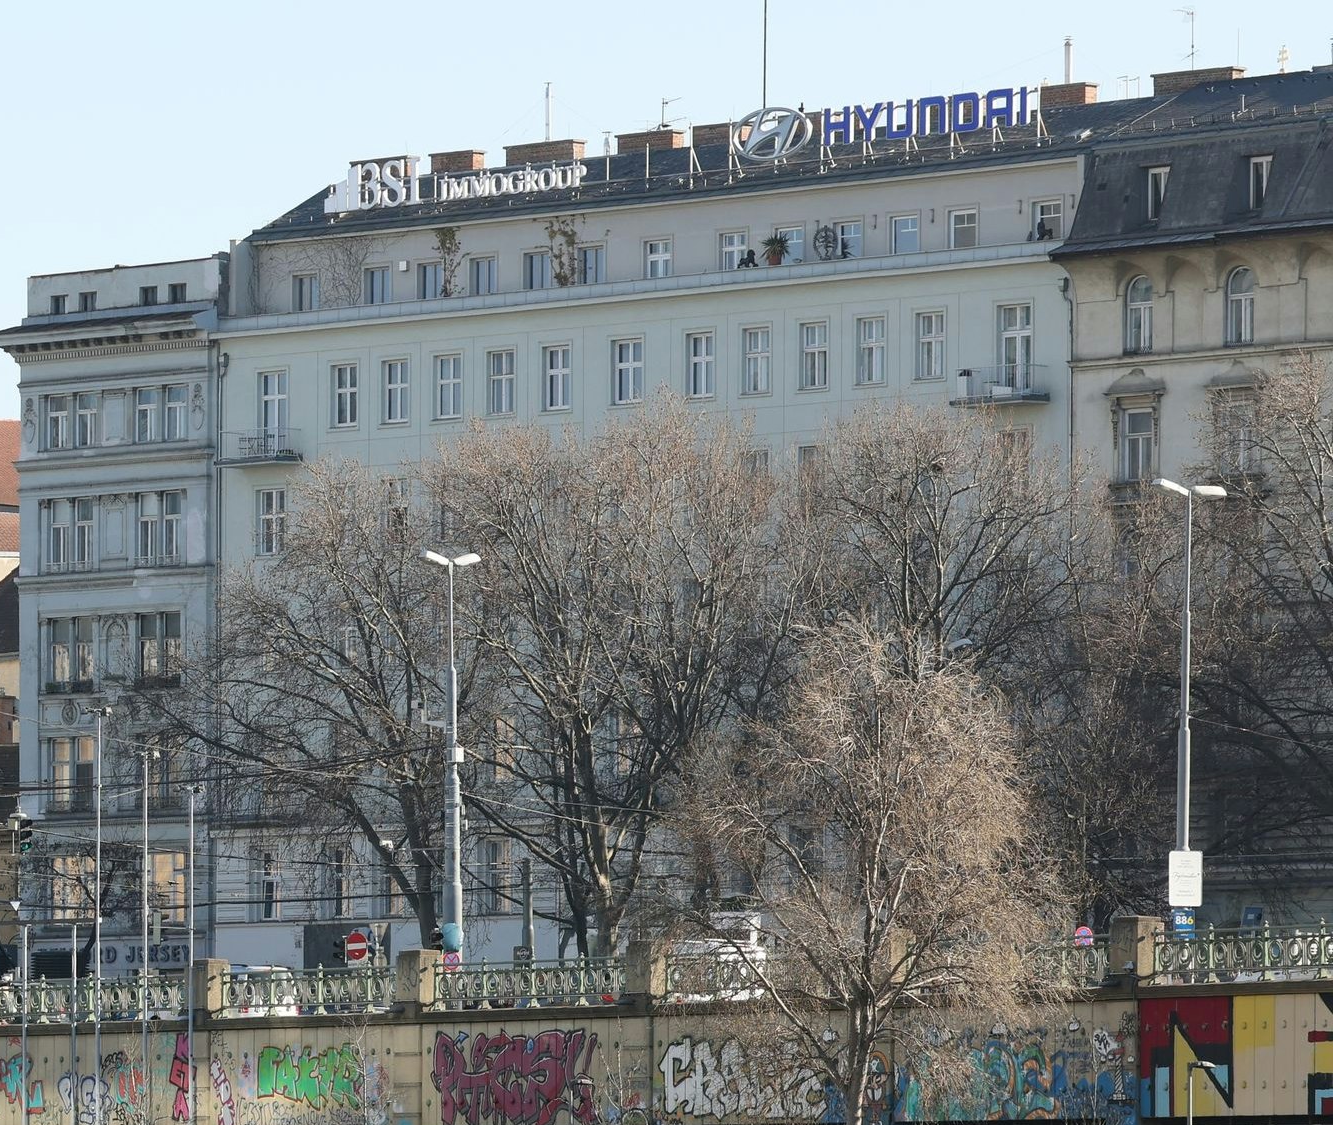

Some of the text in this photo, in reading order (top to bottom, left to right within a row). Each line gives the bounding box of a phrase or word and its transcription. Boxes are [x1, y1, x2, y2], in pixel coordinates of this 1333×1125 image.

[824, 86, 1030, 147] HYUNDAI
[438, 163, 587, 202] IMMOGROUP
[1175, 915, 1194, 925] 886
